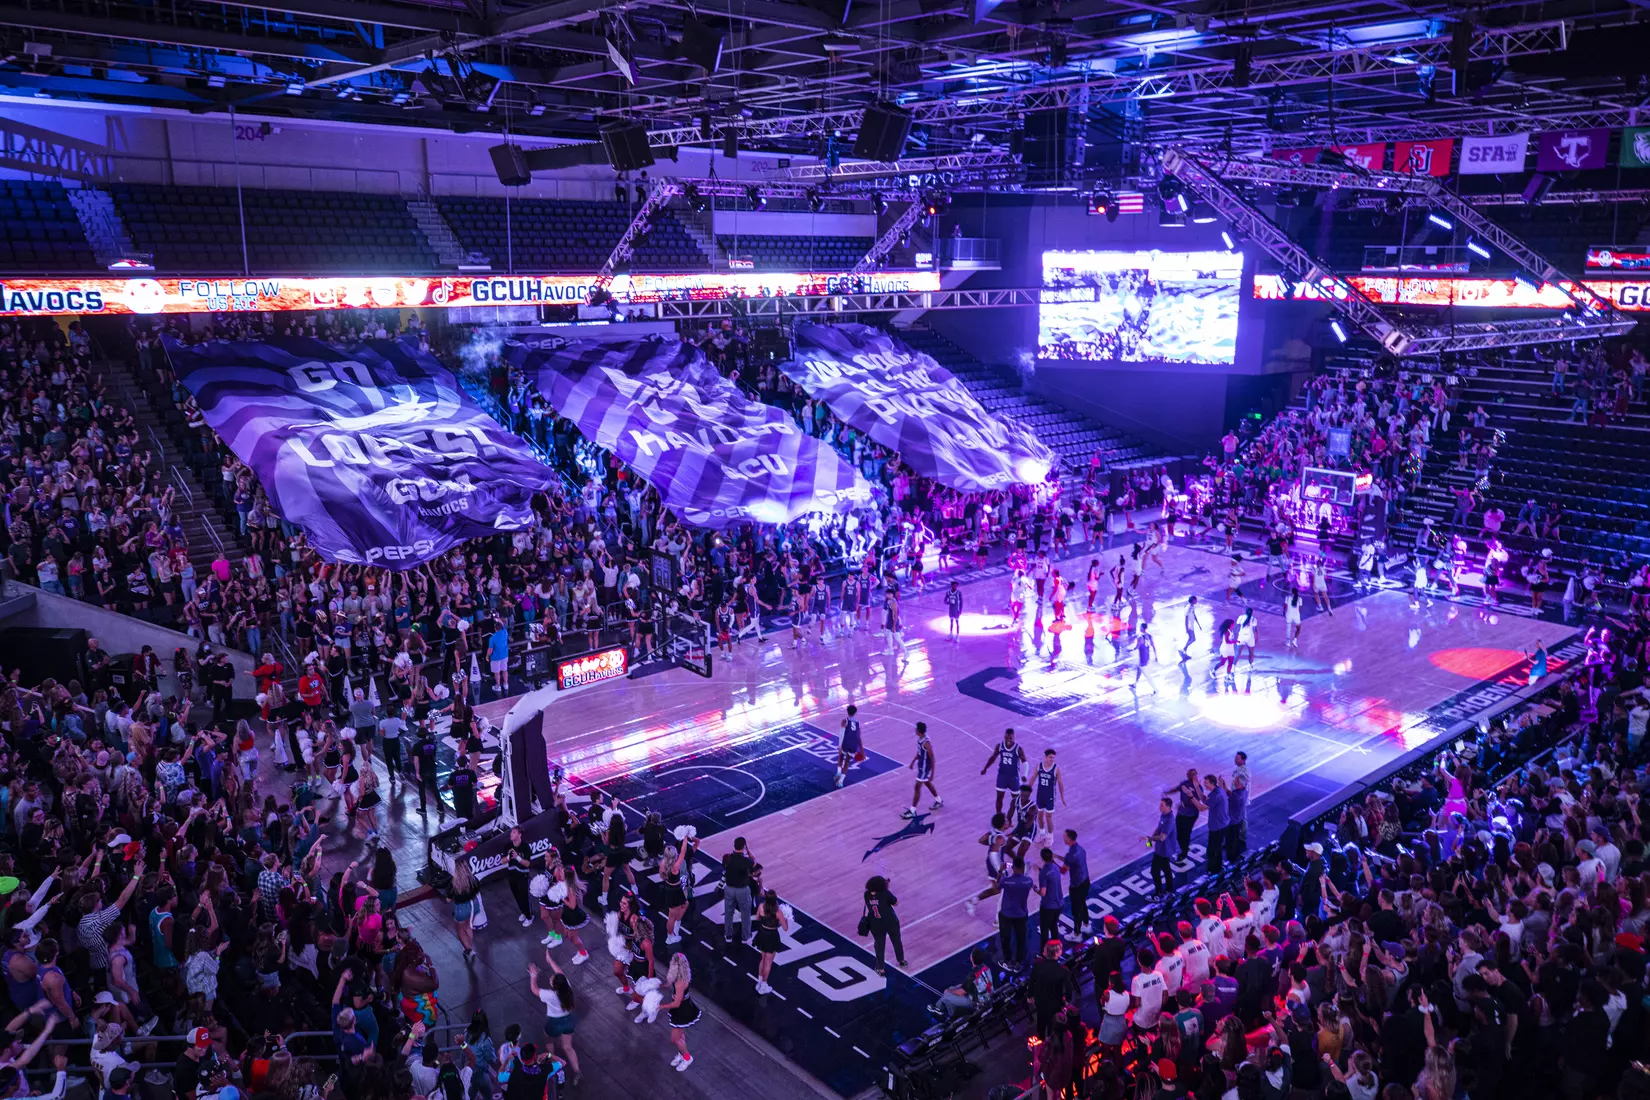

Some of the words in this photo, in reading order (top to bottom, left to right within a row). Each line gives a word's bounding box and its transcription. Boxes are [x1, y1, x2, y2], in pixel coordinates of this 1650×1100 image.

[0, 284, 103, 311] AVOCS
[178, 281, 280, 297] FOLLOW
[207, 297, 229, 310] US
[418, 497, 469, 517] HAVOCS
[366, 540, 435, 563] PEPSI
[1003, 758, 1012, 766] 24
[469, 853, 504, 874] Swee
